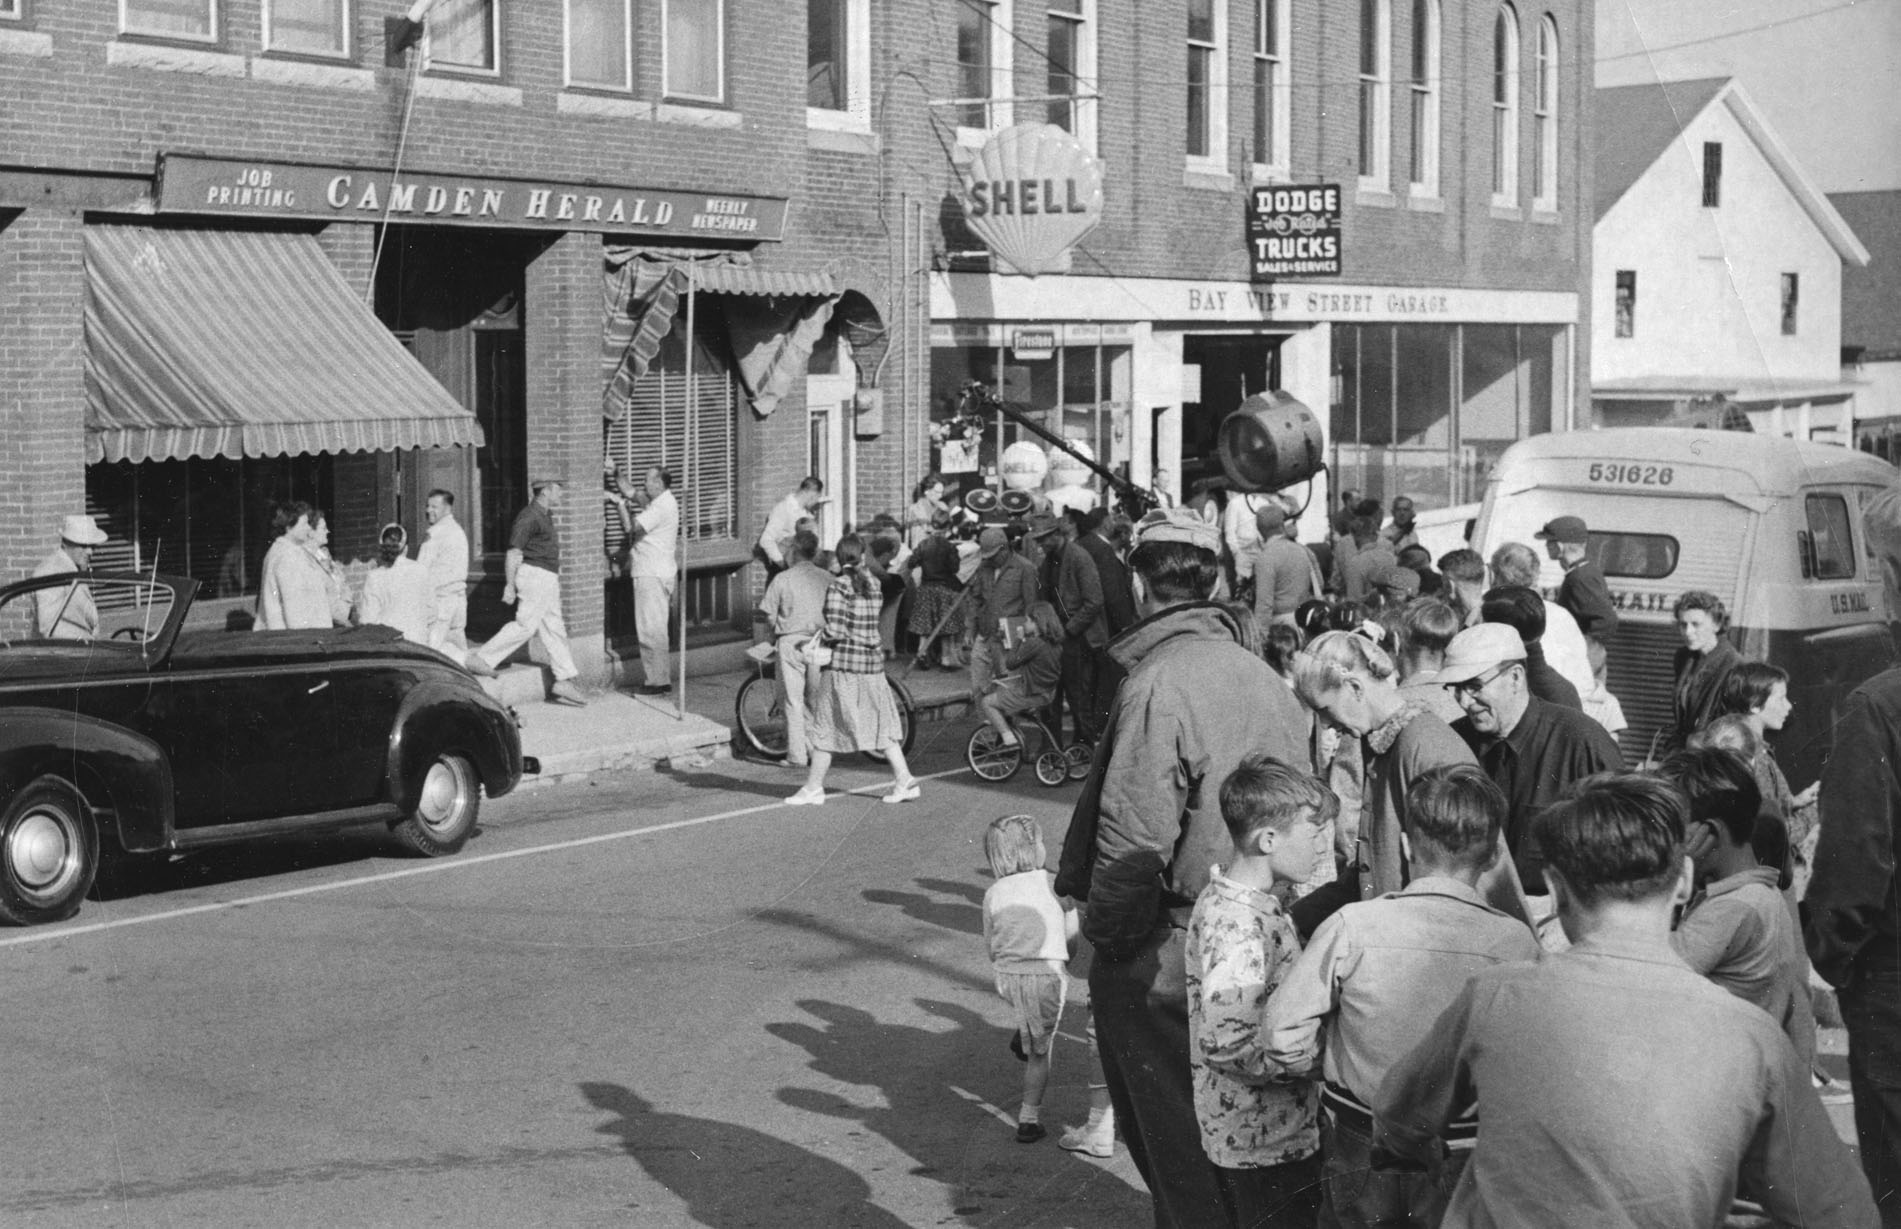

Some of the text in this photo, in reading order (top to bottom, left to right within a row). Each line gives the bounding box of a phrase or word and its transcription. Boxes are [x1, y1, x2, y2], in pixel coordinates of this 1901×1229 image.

[237, 168, 272, 187] JOB
[207, 186, 295, 207] PRINTING
[327, 175, 673, 227] CAMDEN HERALD
[706, 199, 748, 215] WEEKLY
[971, 178, 1087, 217] SHELL
[1256, 189, 1336, 213] DODGE
[692, 213, 758, 232] NEWSPAPER
[1256, 236, 1336, 259] TRUCKS
[1256, 262, 1288, 273] SALES
[1294, 260, 1337, 272] SERVICE
[1188, 288, 1449, 313] BAY VIEW STREET GARAGE
[1608, 590, 1677, 611] MAIL
